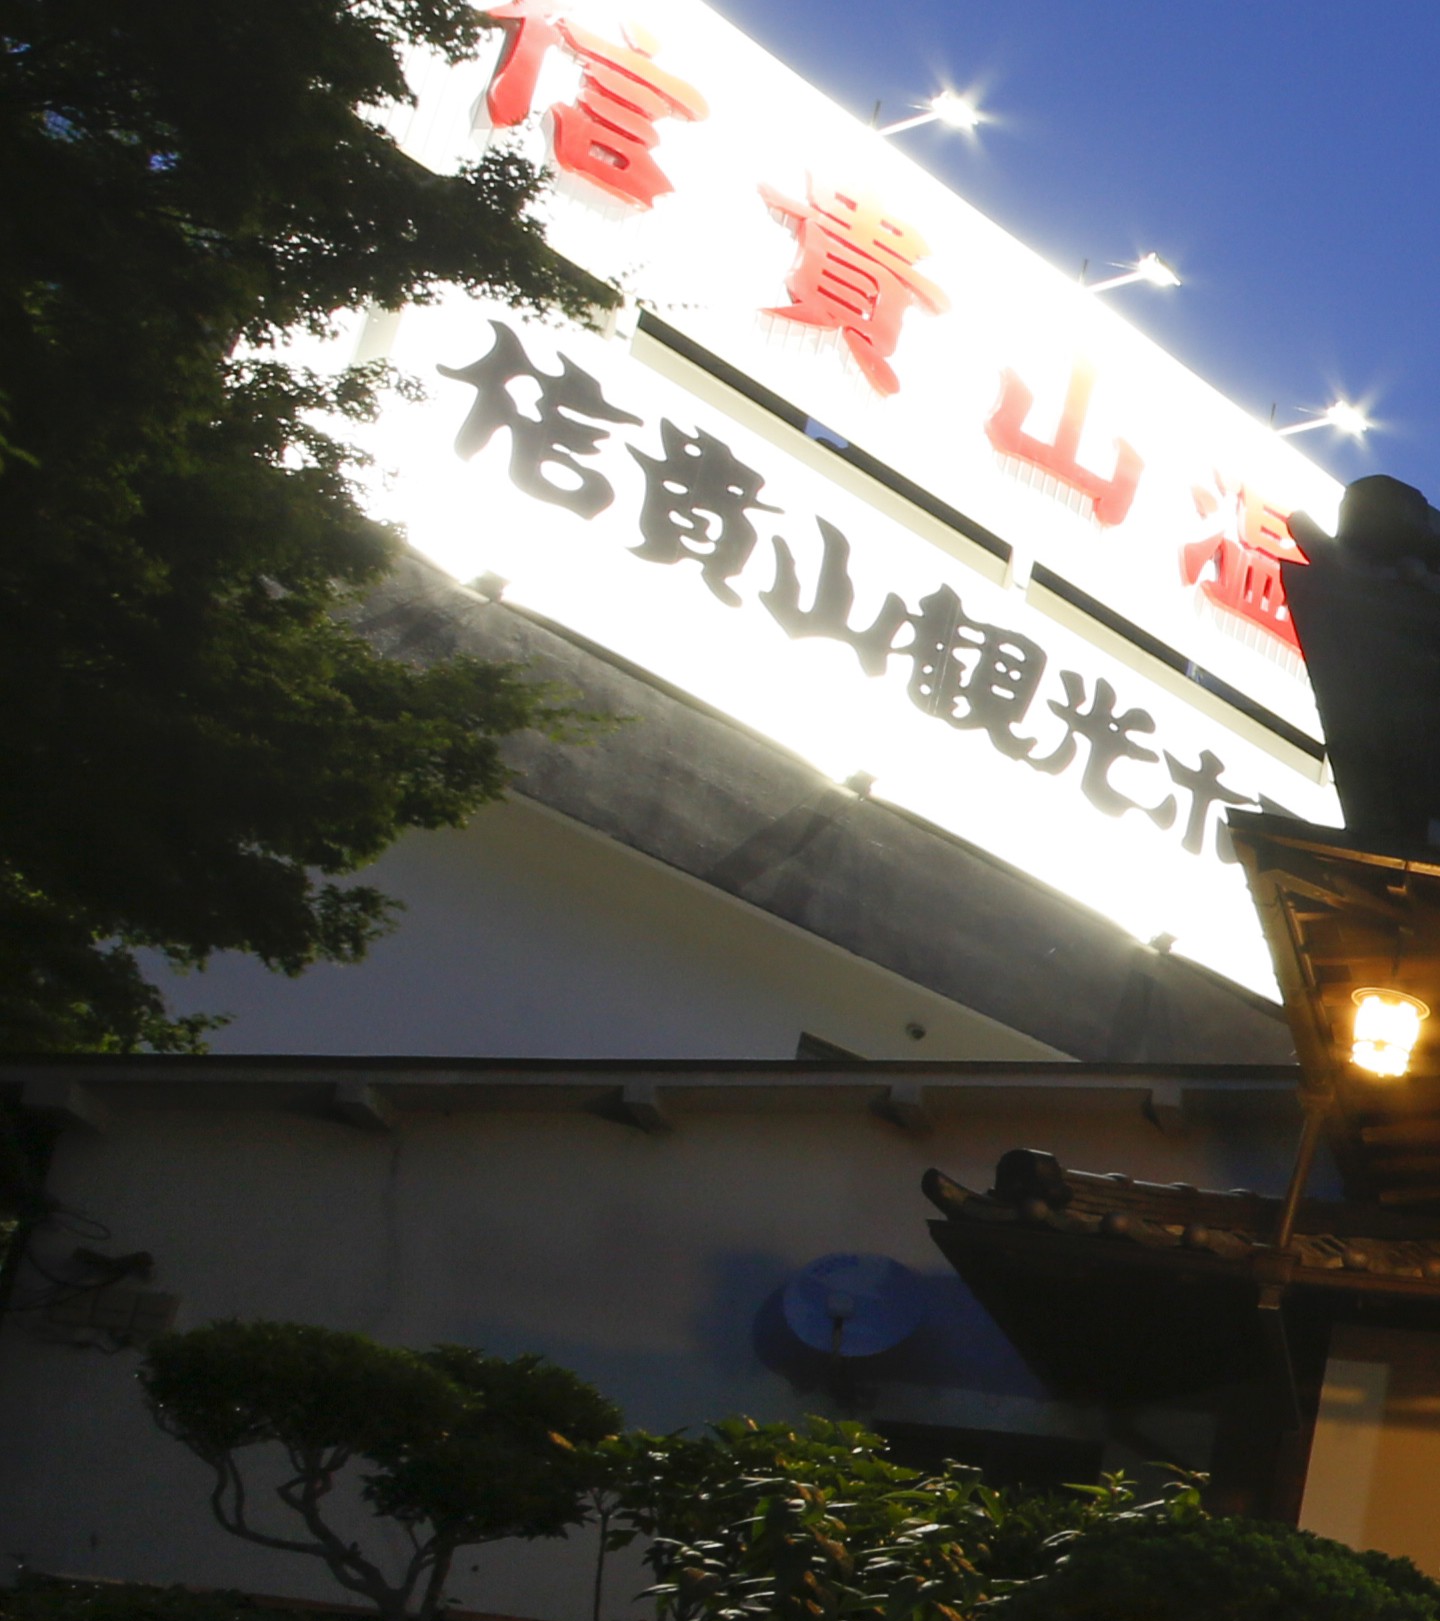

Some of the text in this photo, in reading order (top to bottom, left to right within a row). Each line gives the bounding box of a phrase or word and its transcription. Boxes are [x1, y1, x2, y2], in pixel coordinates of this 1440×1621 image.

[436, 319, 1308, 866] 信貴山観光ホ
